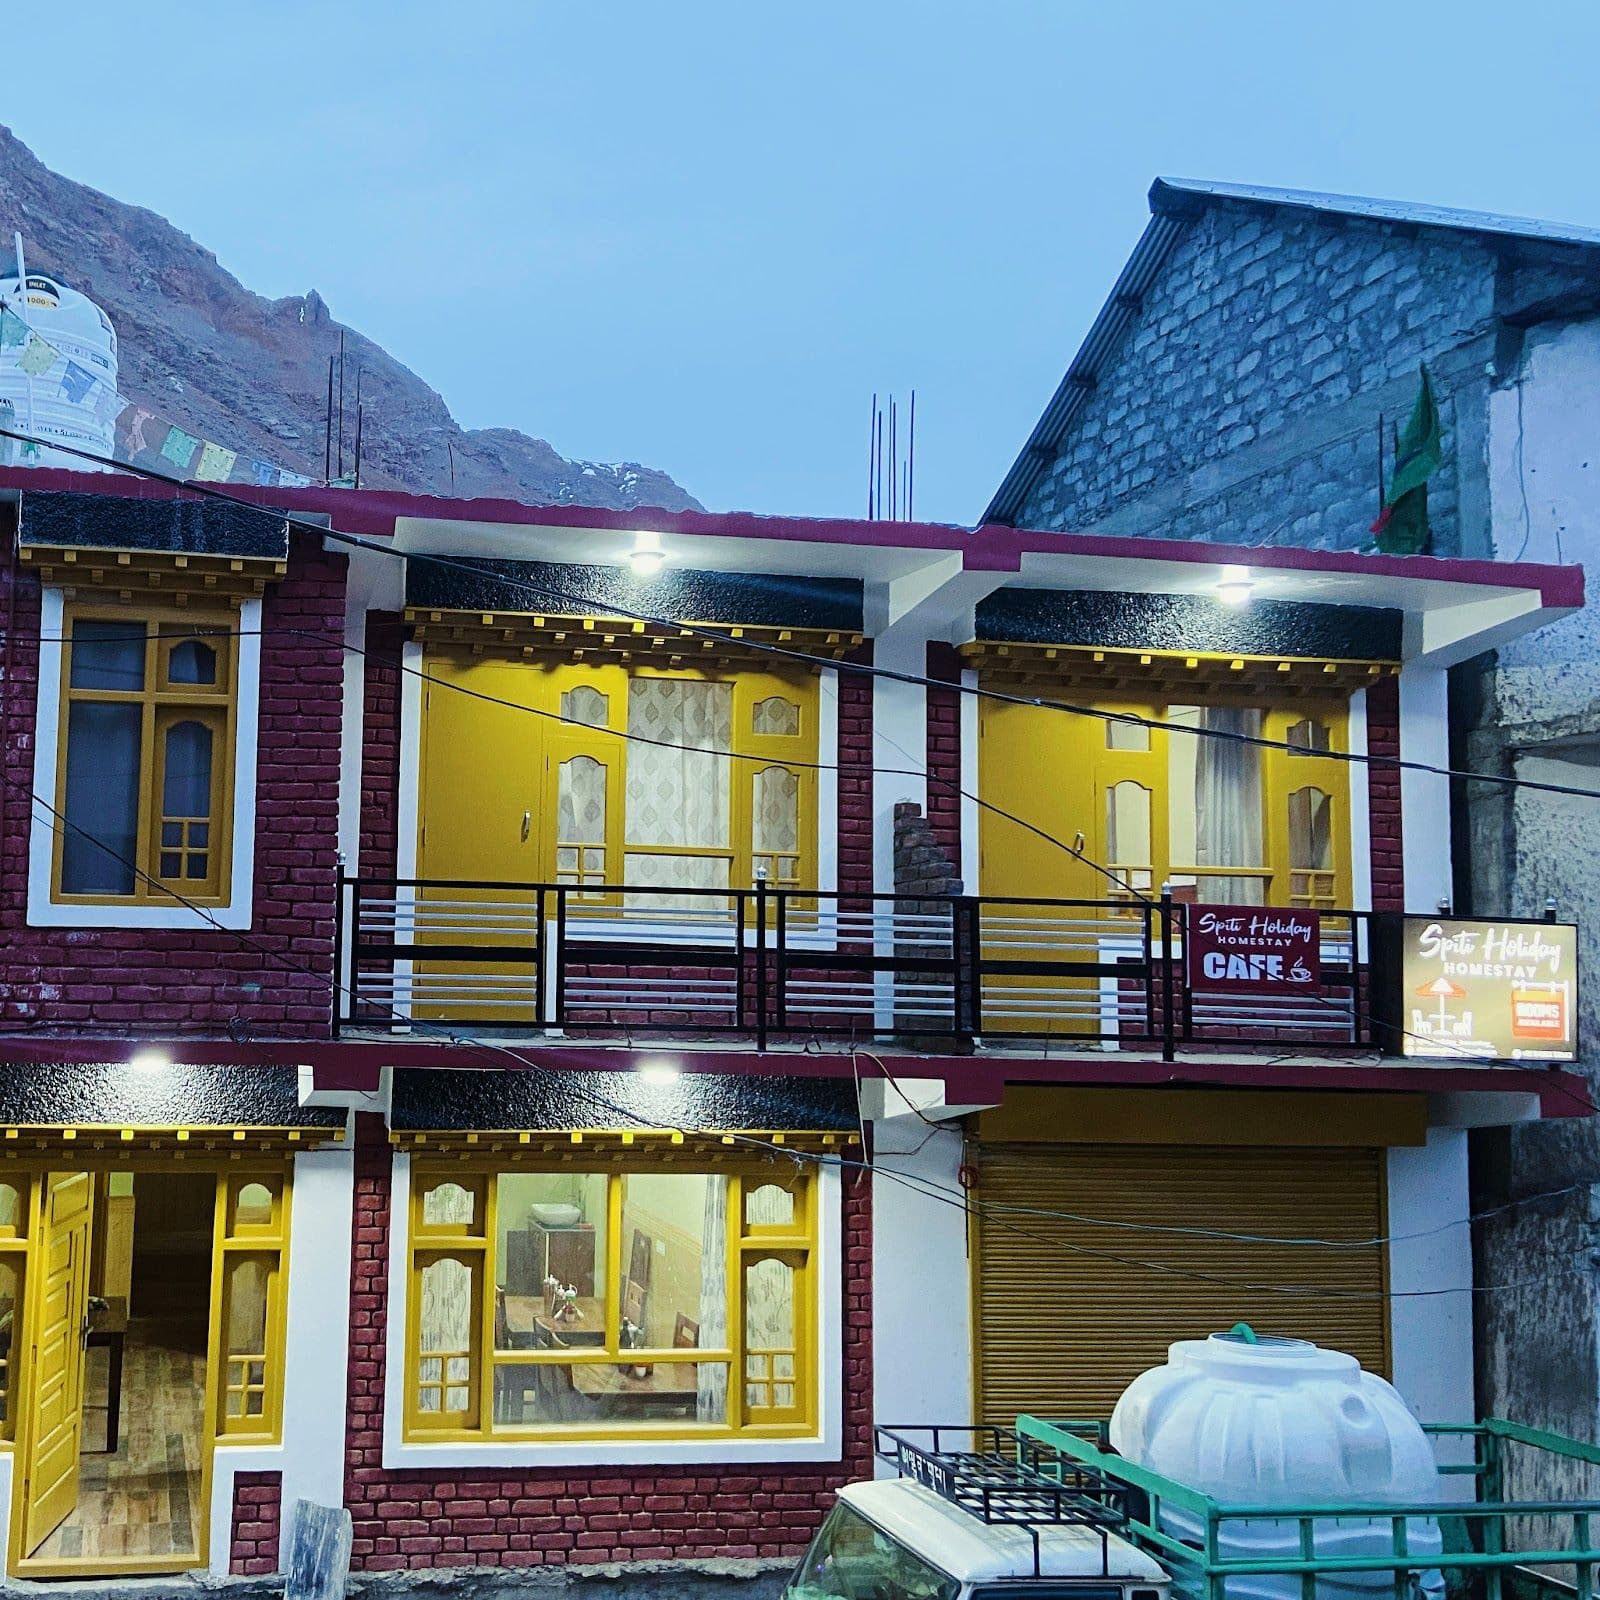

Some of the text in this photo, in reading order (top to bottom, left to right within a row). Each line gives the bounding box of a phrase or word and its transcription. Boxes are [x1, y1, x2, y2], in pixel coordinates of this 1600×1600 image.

[1199, 912, 1312, 943] Spiti Holiday
[1217, 936, 1292, 947] HOMESTAY
[1419, 923, 1562, 974] Spiti Holiday
[1203, 951, 1285, 981] CAFE
[1443, 961, 1537, 978] HOMESTAY
